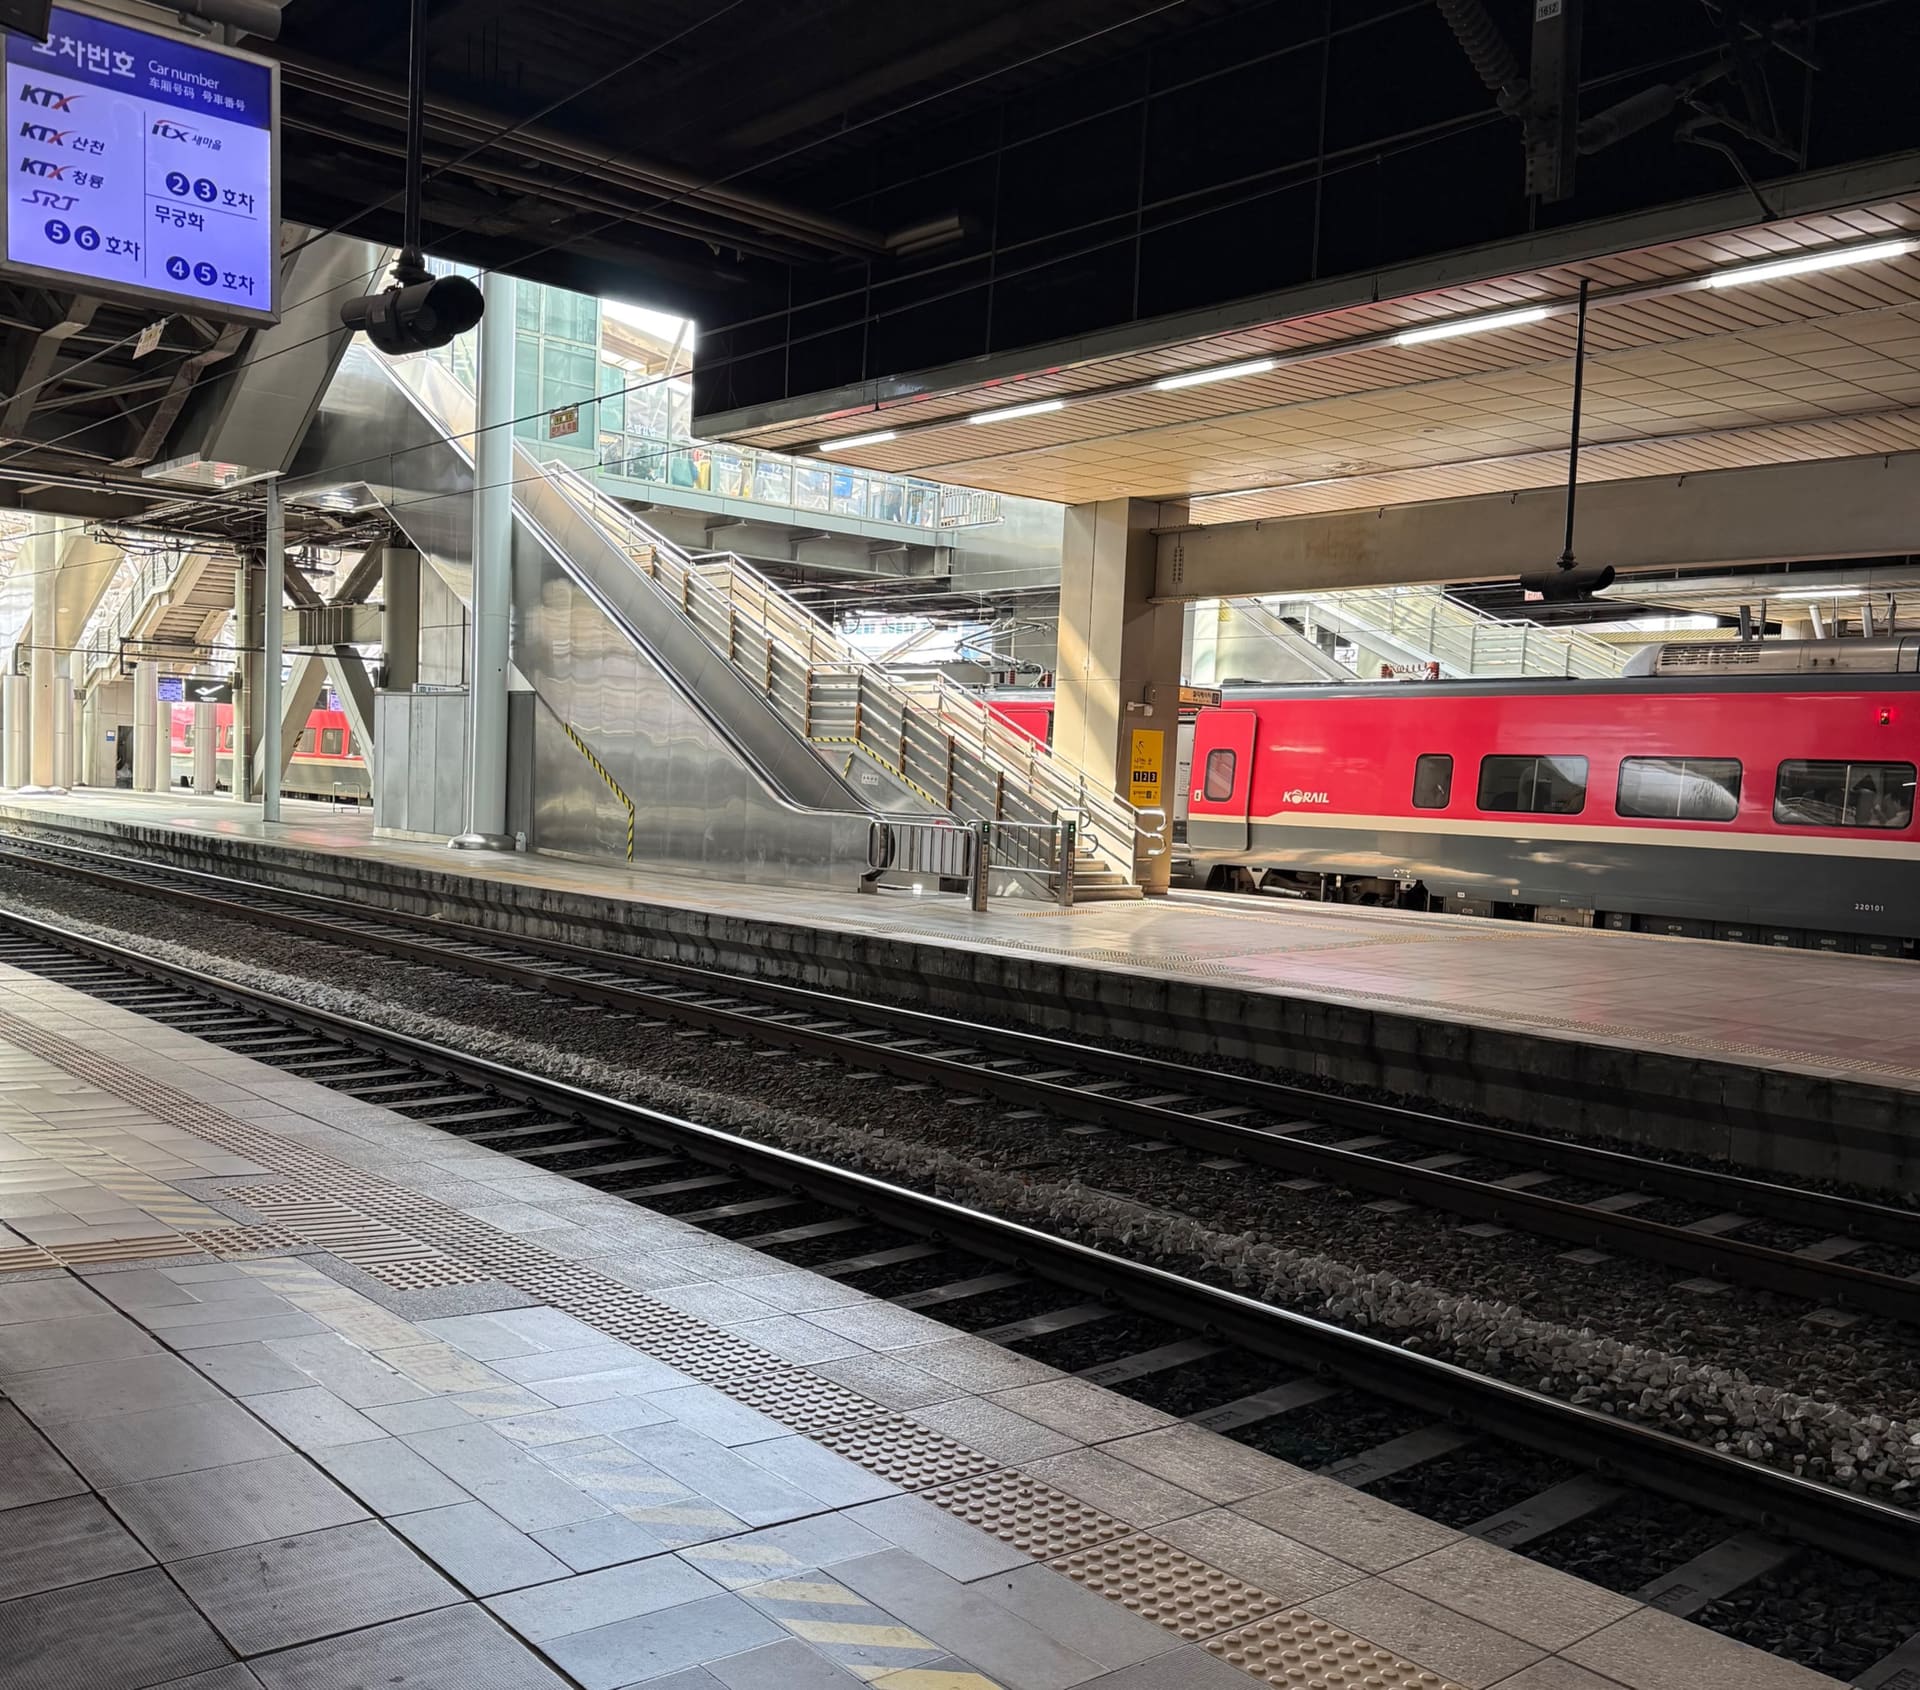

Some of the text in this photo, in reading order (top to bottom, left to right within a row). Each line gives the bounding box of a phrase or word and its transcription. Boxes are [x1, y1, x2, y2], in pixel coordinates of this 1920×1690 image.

[148, 60, 220, 90] Car number
[20, 84, 85, 113] KTX
[20, 122, 106, 156] KTX 산천
[191, 134, 223, 151] 새마을
[20, 157, 105, 189] KTX 청룡
[21, 189, 80, 212] SRT
[222, 188, 255, 214] 호차
[155, 204, 206, 232] 무궁화
[105, 236, 141, 262] 호차
[222, 271, 255, 296] 호차
[1282, 789, 1330, 805] KORAIL
